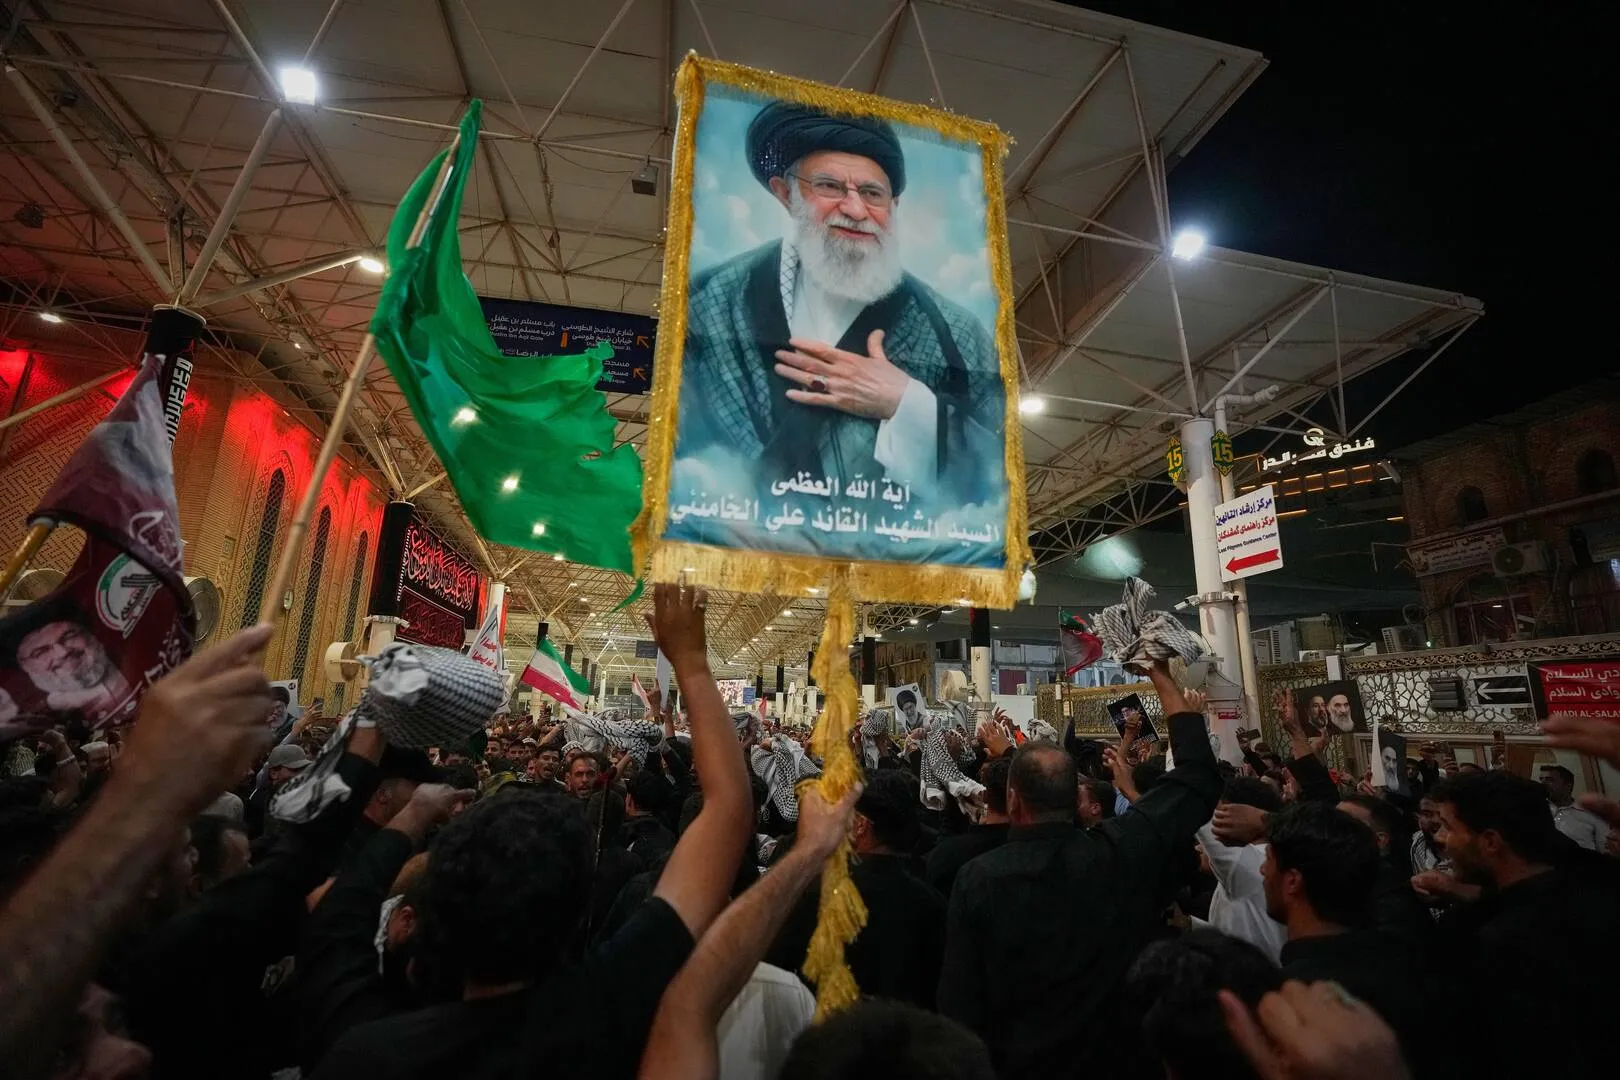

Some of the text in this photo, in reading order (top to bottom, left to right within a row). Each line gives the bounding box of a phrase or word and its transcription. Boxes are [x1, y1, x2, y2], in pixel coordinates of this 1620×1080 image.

[1212, 442, 1233, 462] 15
[1329, 437, 1375, 459] فندق
[1167, 447, 1183, 470] 15
[771, 471, 911, 510] آية الله العظمى
[1256, 497, 1272, 511] مركز
[670, 489, 1000, 547] السيد الشهيد القائد علي الخامنئي
[1545, 668, 1594, 682] السلام
[1549, 686, 1587, 702] السلام
[1580, 710, 1620, 718] AL-SALA
